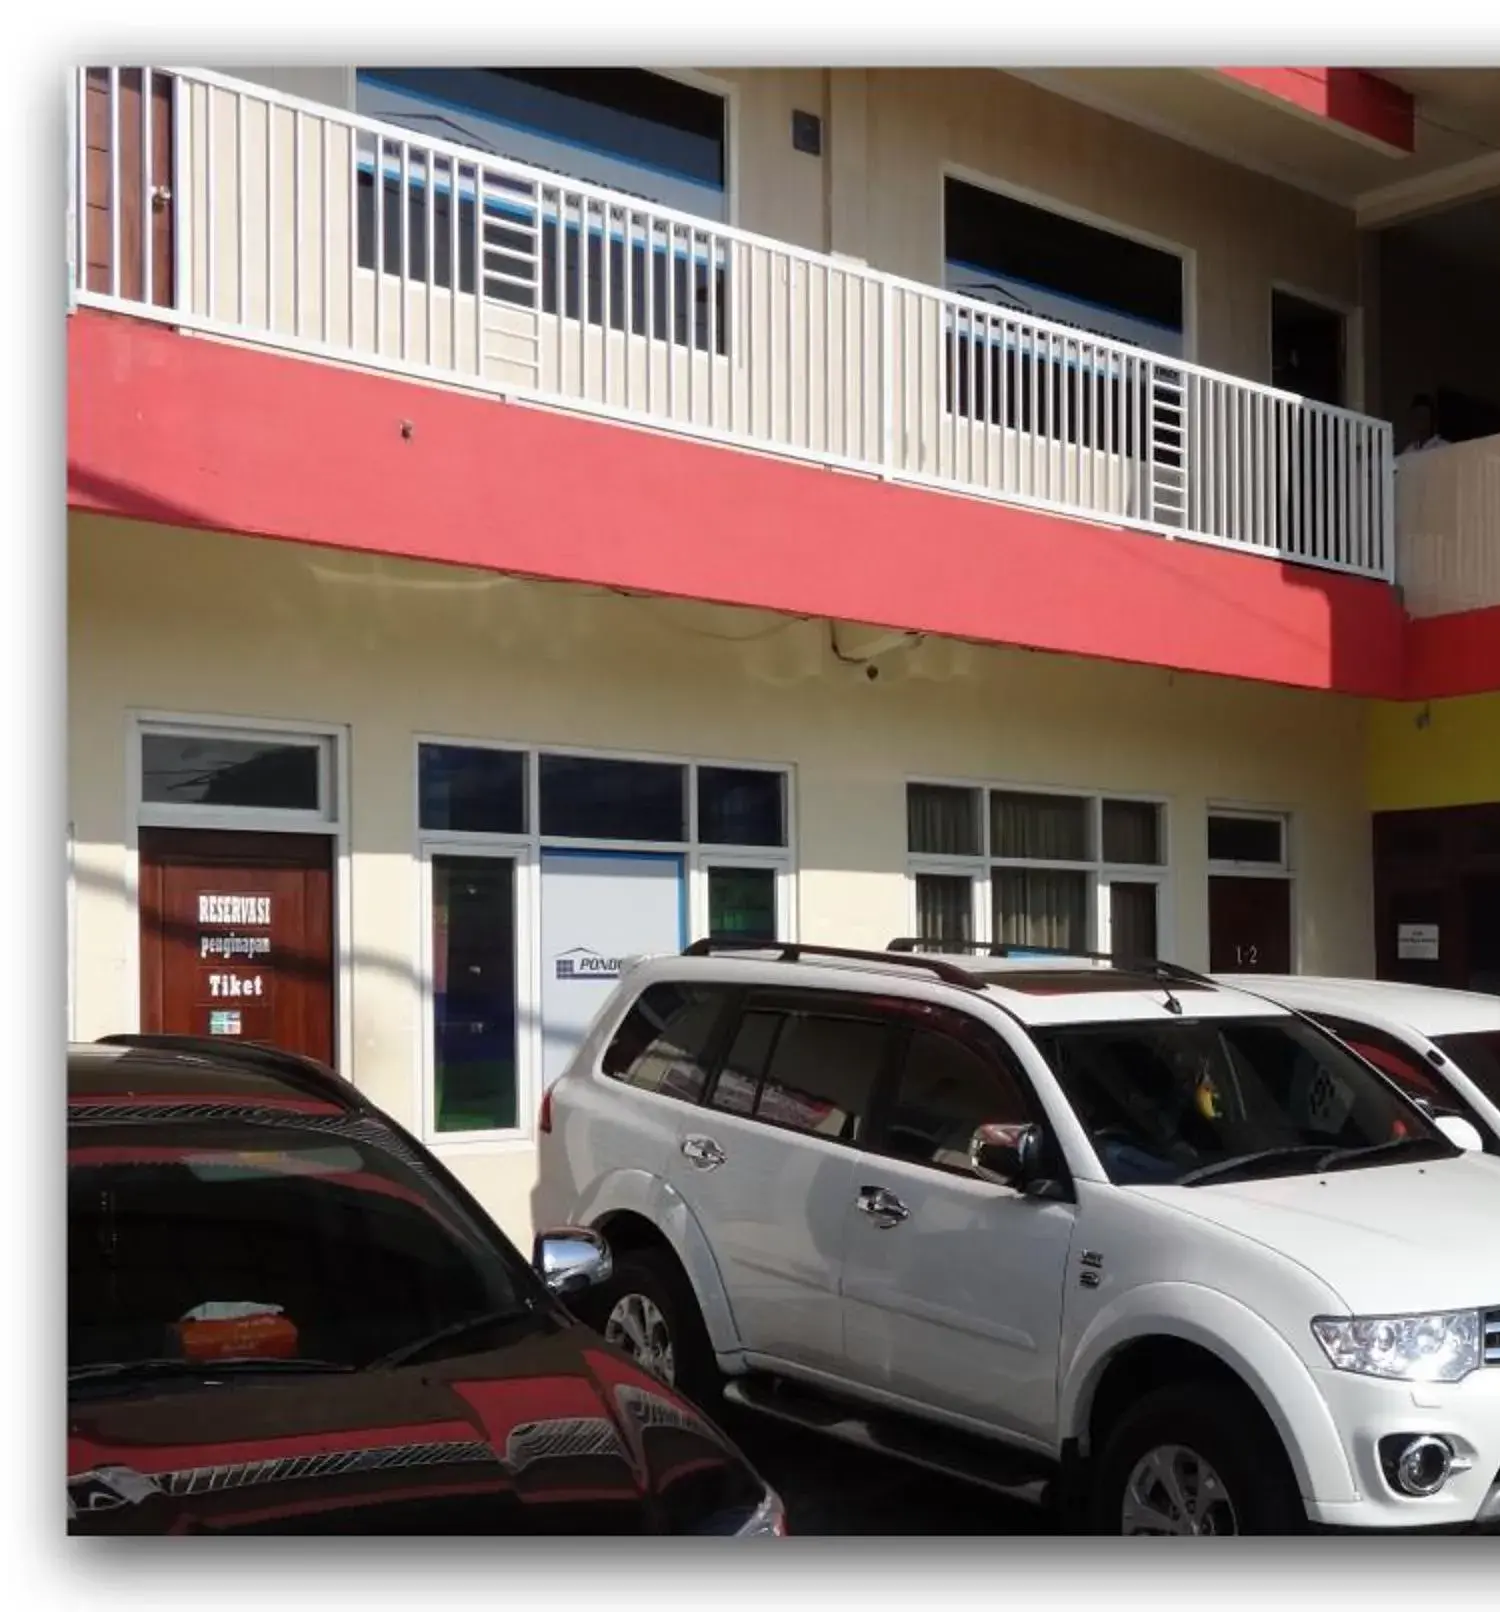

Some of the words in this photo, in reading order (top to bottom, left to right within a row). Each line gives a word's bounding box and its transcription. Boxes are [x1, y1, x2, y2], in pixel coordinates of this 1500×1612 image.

[199, 895, 271, 924] RESERVASI
[201, 931, 270, 958] penginapan
[580, 958, 622, 971] POND
[209, 974, 262, 996] Tiket
